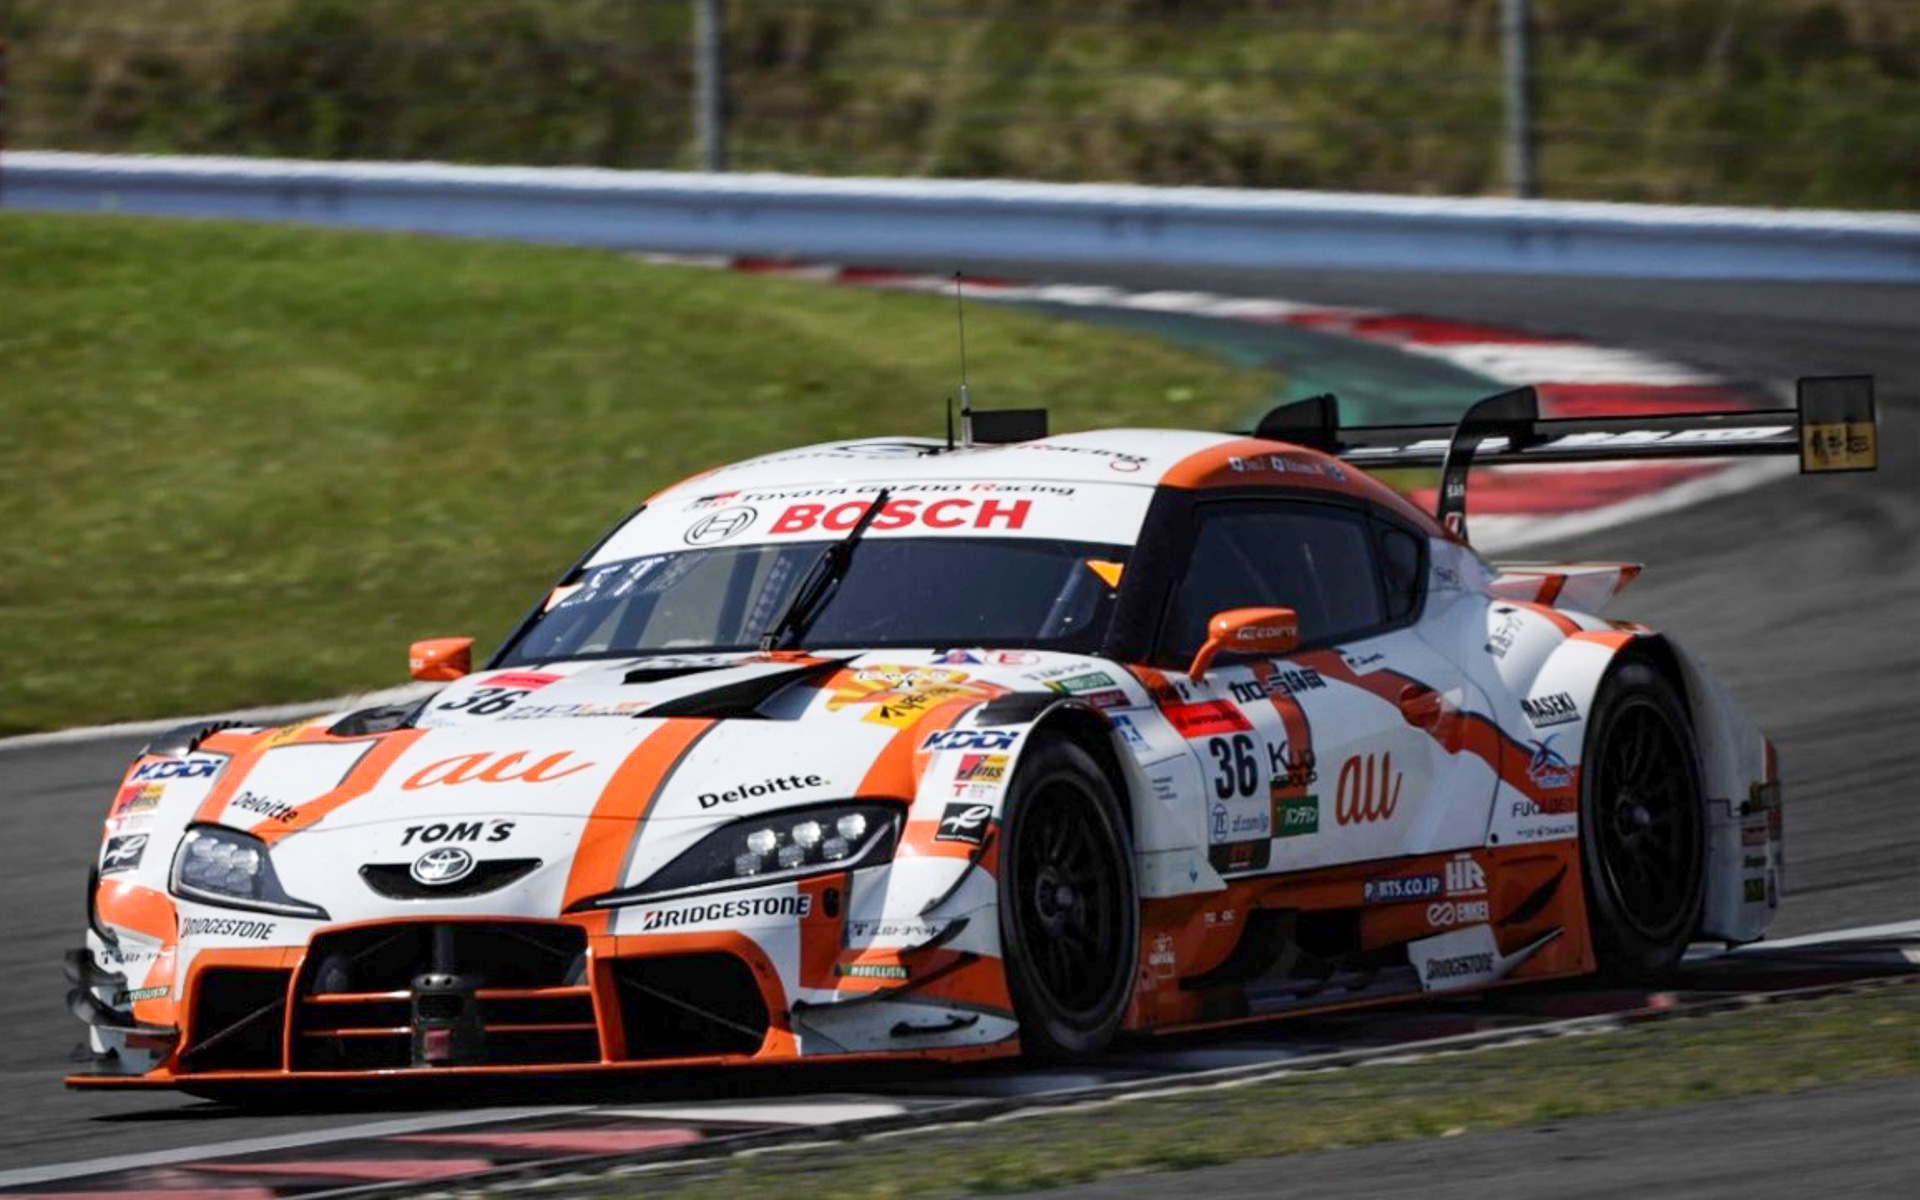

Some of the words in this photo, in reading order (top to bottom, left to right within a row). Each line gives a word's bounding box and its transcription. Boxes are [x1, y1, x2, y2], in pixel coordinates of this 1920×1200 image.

[744, 487, 847, 502] TOYOTA
[969, 483, 1076, 496] Racing
[769, 499, 1032, 534] BOSCH
[436, 687, 532, 715] 36
[921, 730, 1019, 750] KDDI
[132, 758, 223, 780] KDDI
[401, 750, 596, 790] au
[1209, 734, 1258, 799] 36
[1336, 751, 1402, 826] au
[401, 820, 516, 846] TOM'S
[643, 894, 811, 931] BRIDGESTONE
[181, 917, 277, 941] BRIDGESTONE
